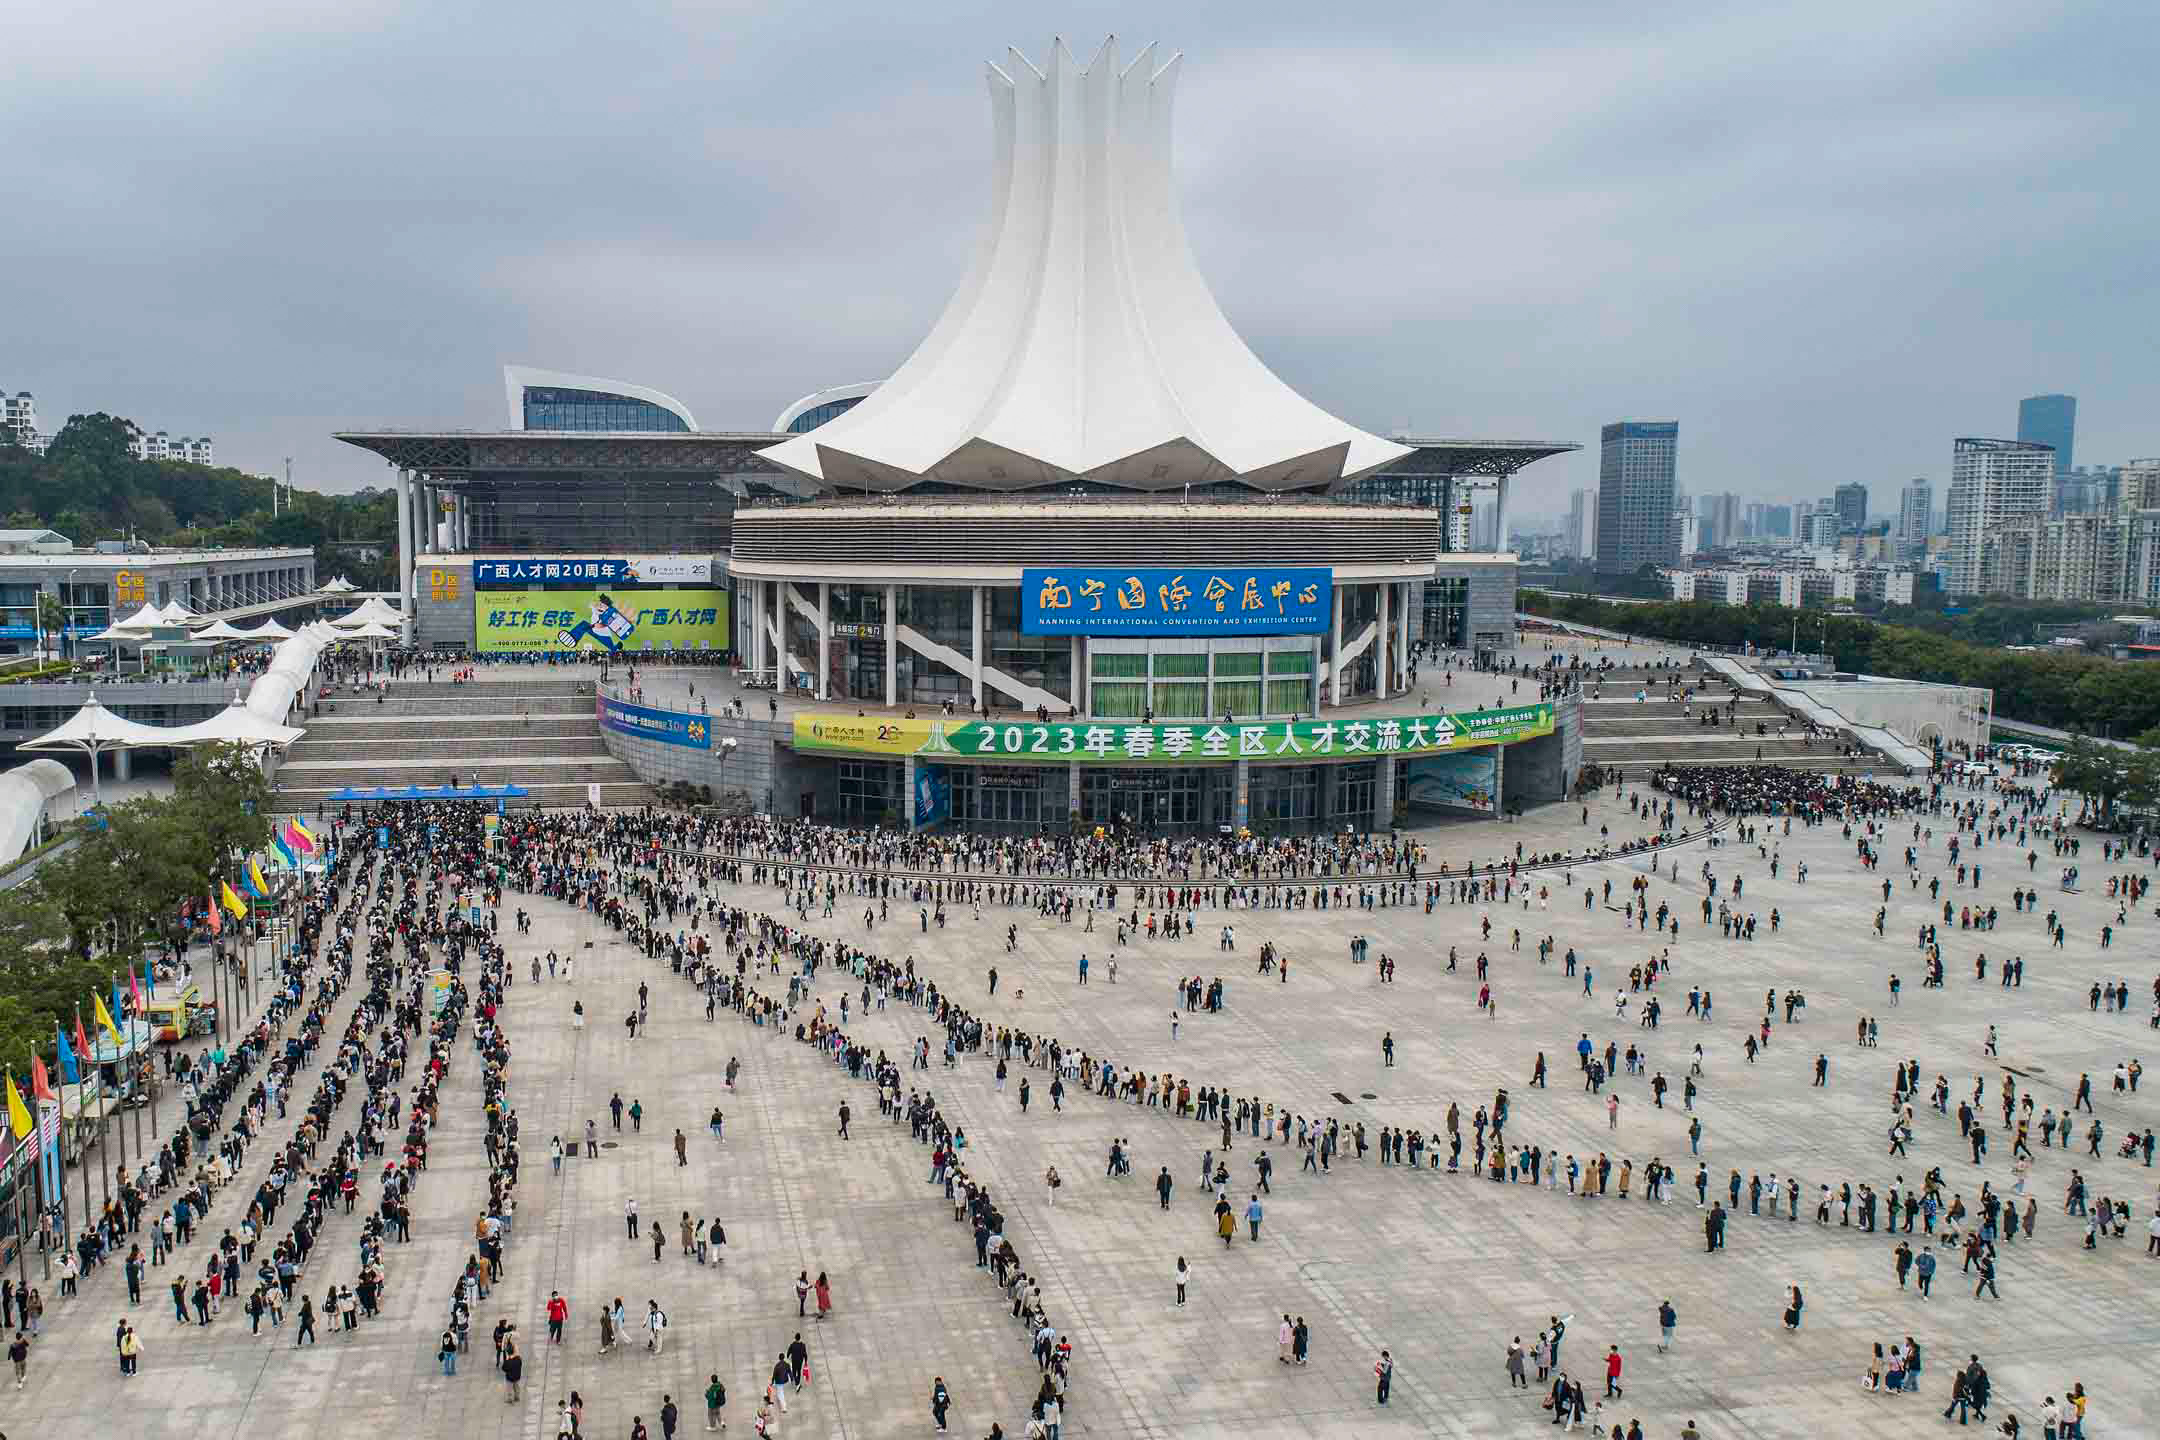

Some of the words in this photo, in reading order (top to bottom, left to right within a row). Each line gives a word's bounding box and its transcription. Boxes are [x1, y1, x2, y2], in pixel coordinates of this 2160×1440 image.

[479, 563, 616, 578] 广西人才网20周年
[487, 610, 539, 628] 好工作
[542, 610, 577, 628] 尽在
[636, 608, 718, 626] 广西人才网
[1290, 616, 1317, 624] CENTER
[978, 716, 1456, 758] 2023年春季全区人才交流大会
